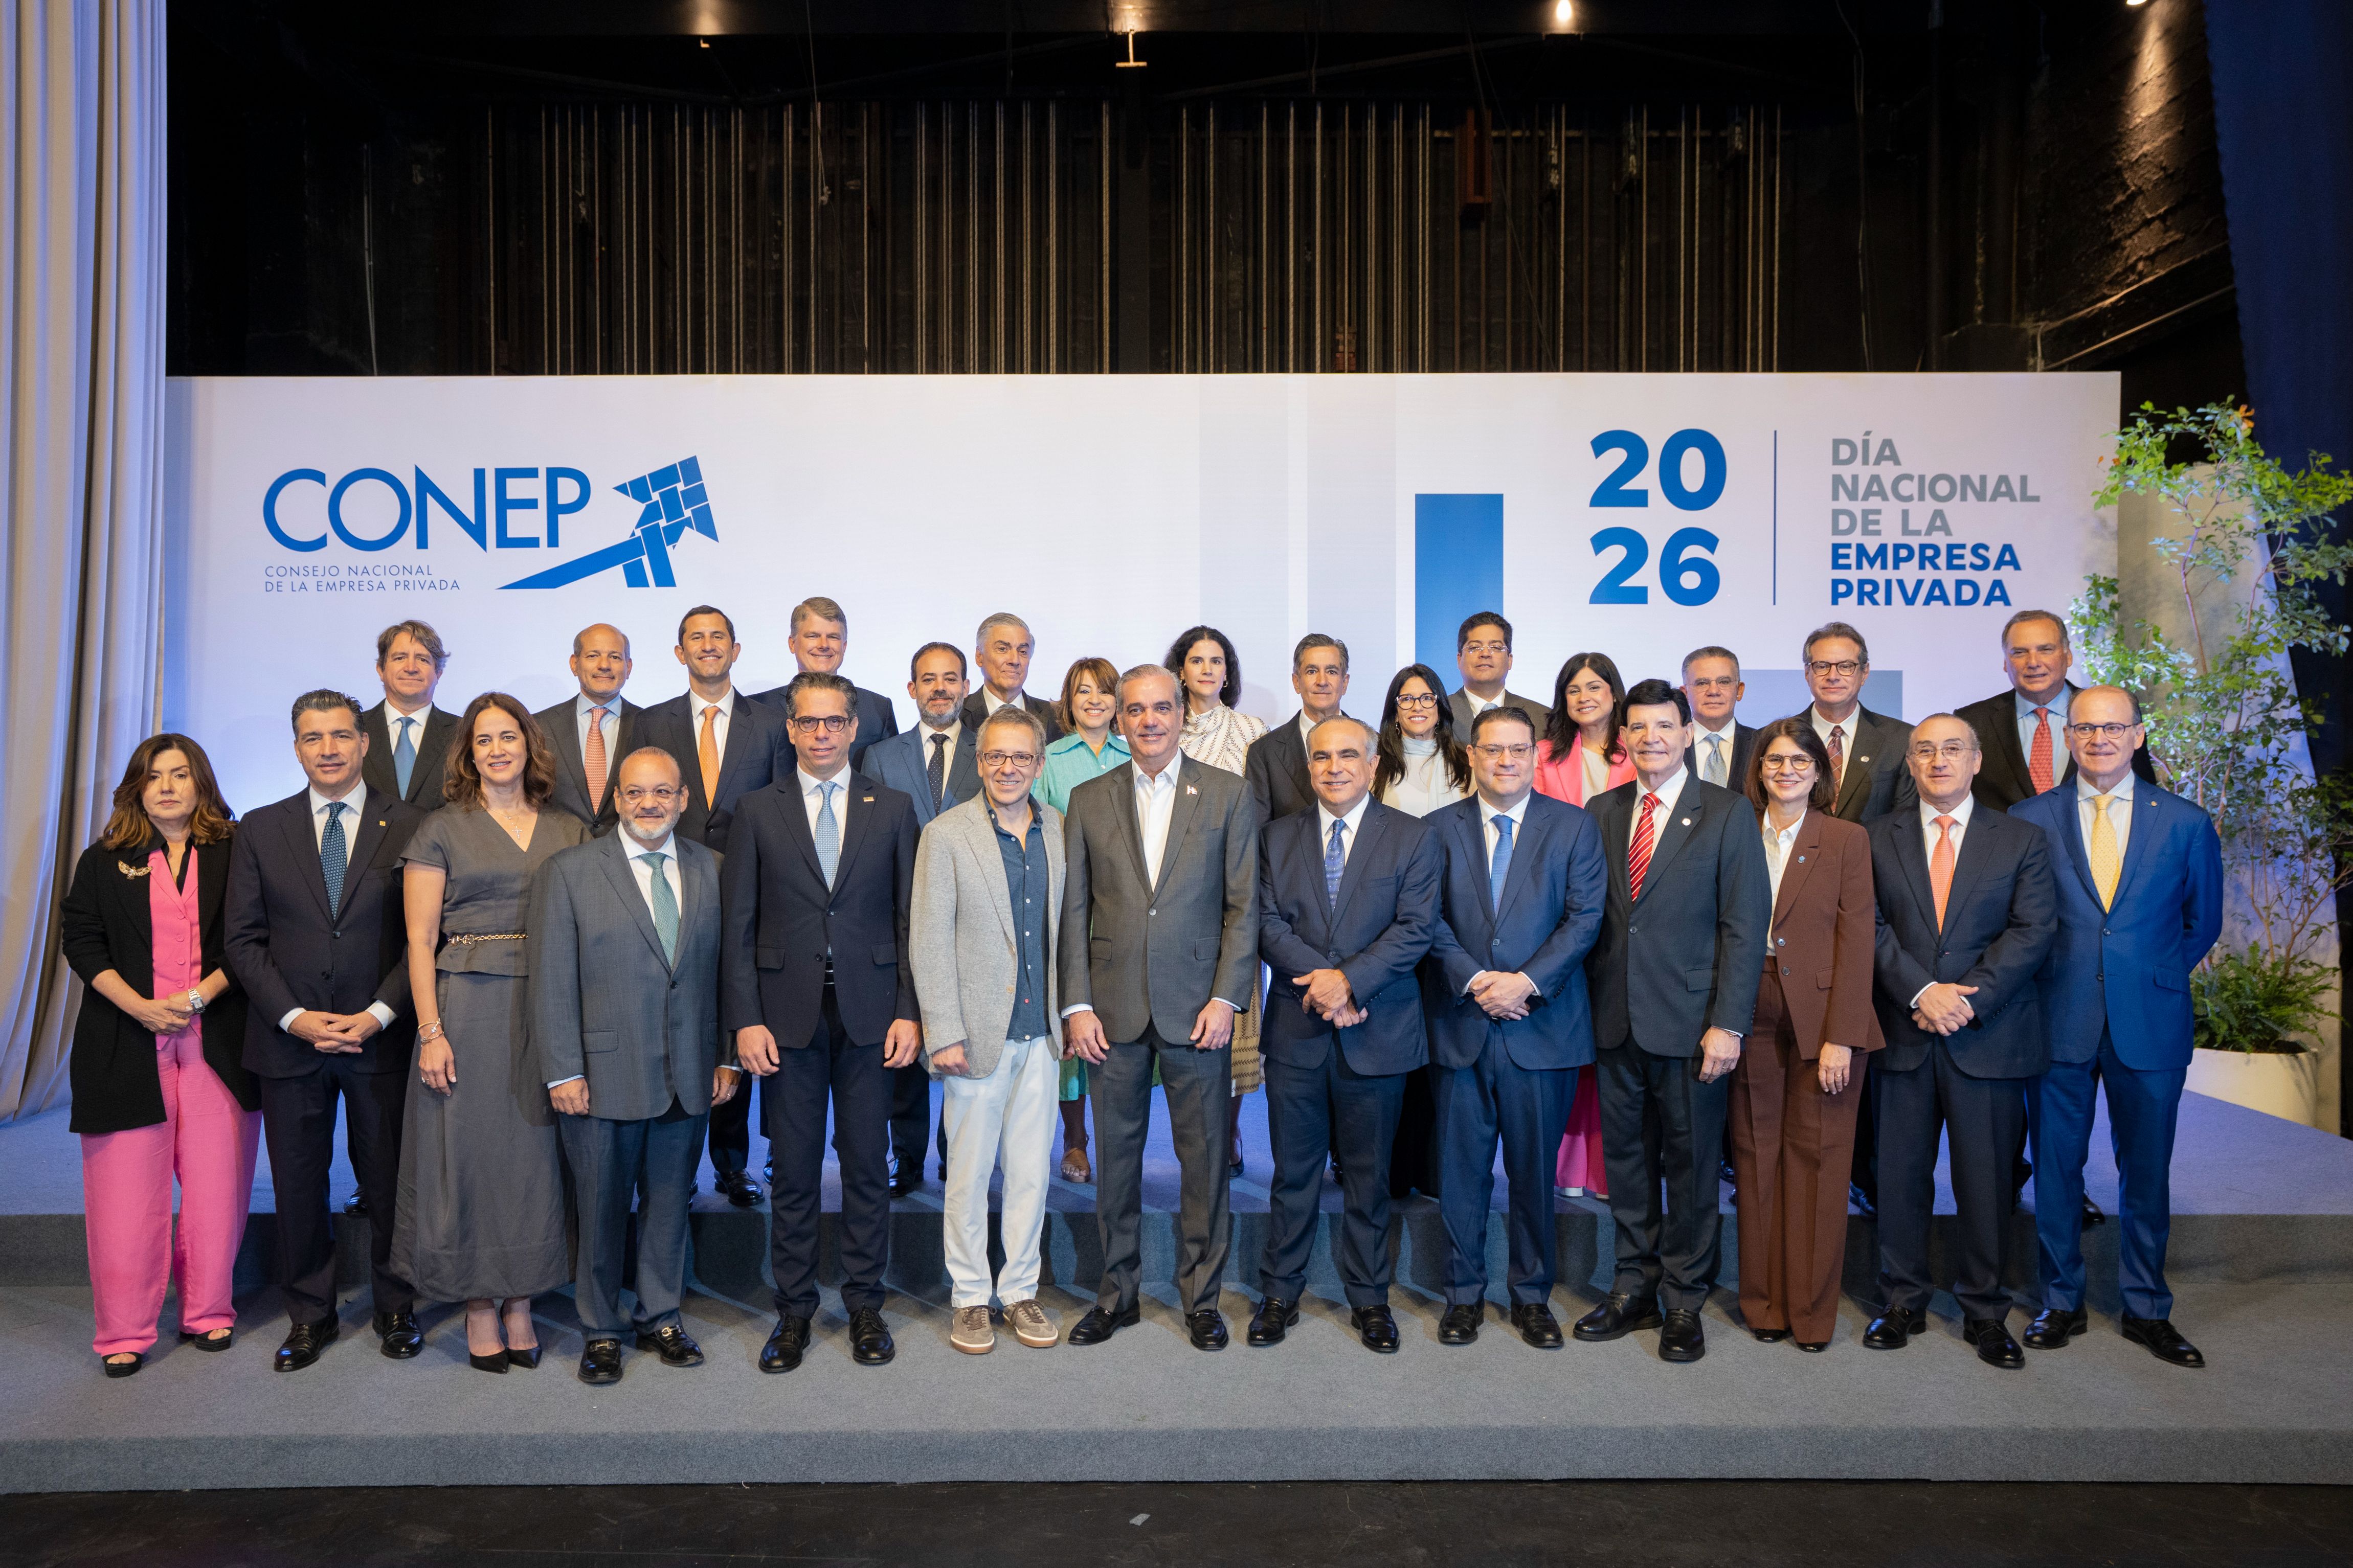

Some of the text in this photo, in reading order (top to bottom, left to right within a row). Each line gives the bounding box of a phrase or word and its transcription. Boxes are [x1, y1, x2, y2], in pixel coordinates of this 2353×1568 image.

[1832, 430, 1902, 466] DÍA
[1589, 428, 1727, 511] 20
[1831, 473, 2041, 503] NACIONAL
[263, 464, 591, 553] CONEP
[1831, 509, 1953, 536] DE LA
[265, 564, 433, 577] CONSEJO NACIONAL
[1589, 527, 1720, 606] 26
[1831, 542, 2022, 571] EMPRESA
[265, 579, 460, 592] DE LA EMPRESA PRIVADA
[1831, 578, 2011, 606] PRIVADA
